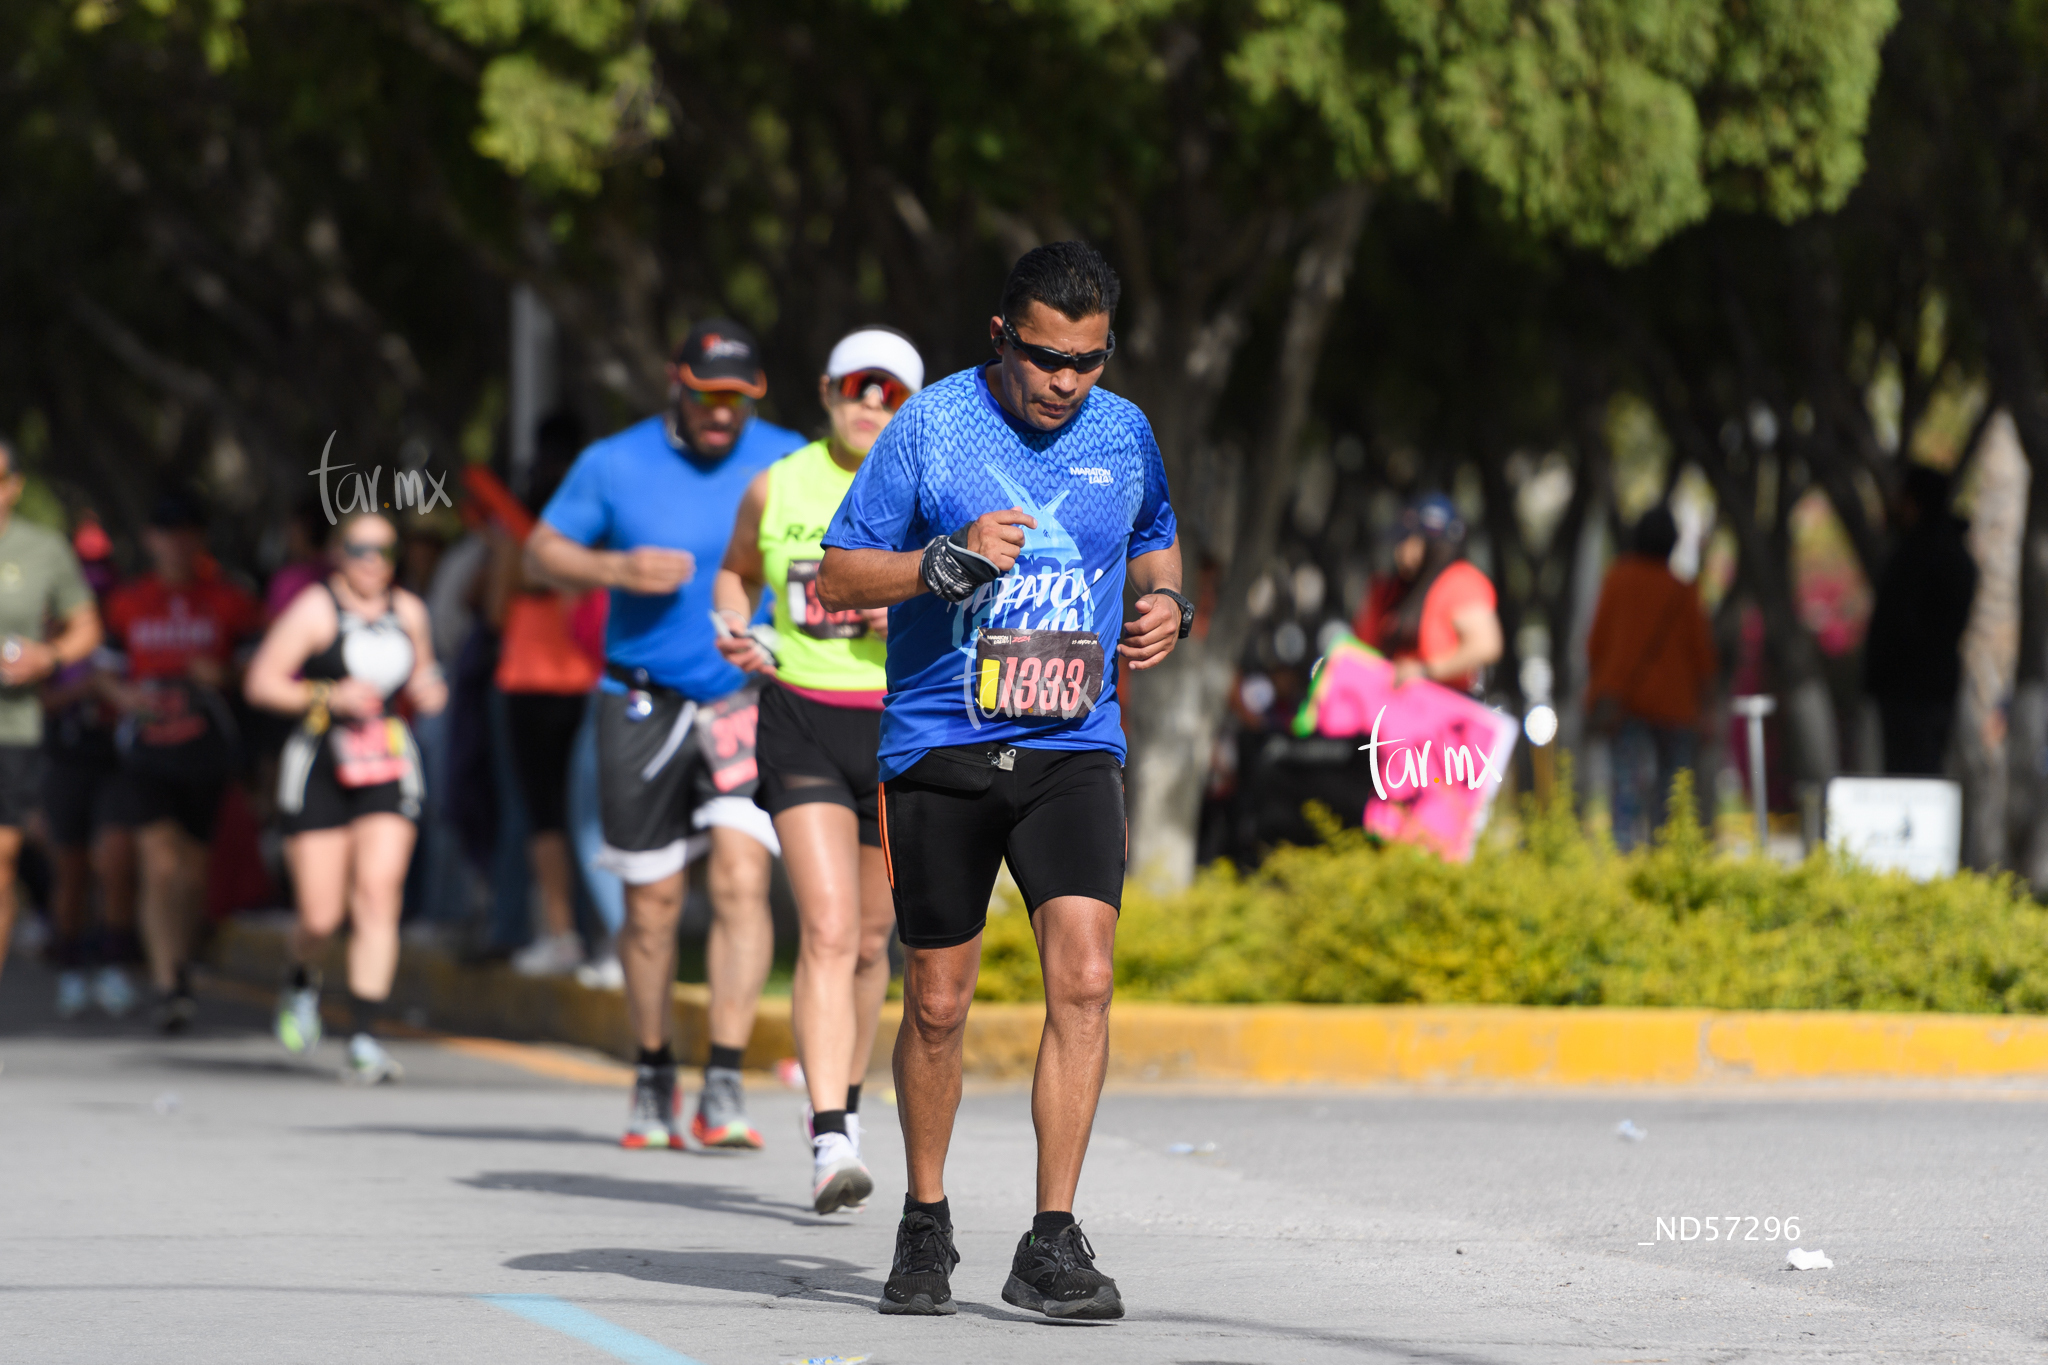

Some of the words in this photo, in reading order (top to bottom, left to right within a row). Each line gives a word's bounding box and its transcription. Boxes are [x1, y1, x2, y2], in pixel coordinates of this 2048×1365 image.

[1069, 467, 1111, 476] MARATÓN
[784, 524, 826, 541] RA
[946, 568, 1104, 615] ARATÓN
[999, 656, 1085, 711] 1333
